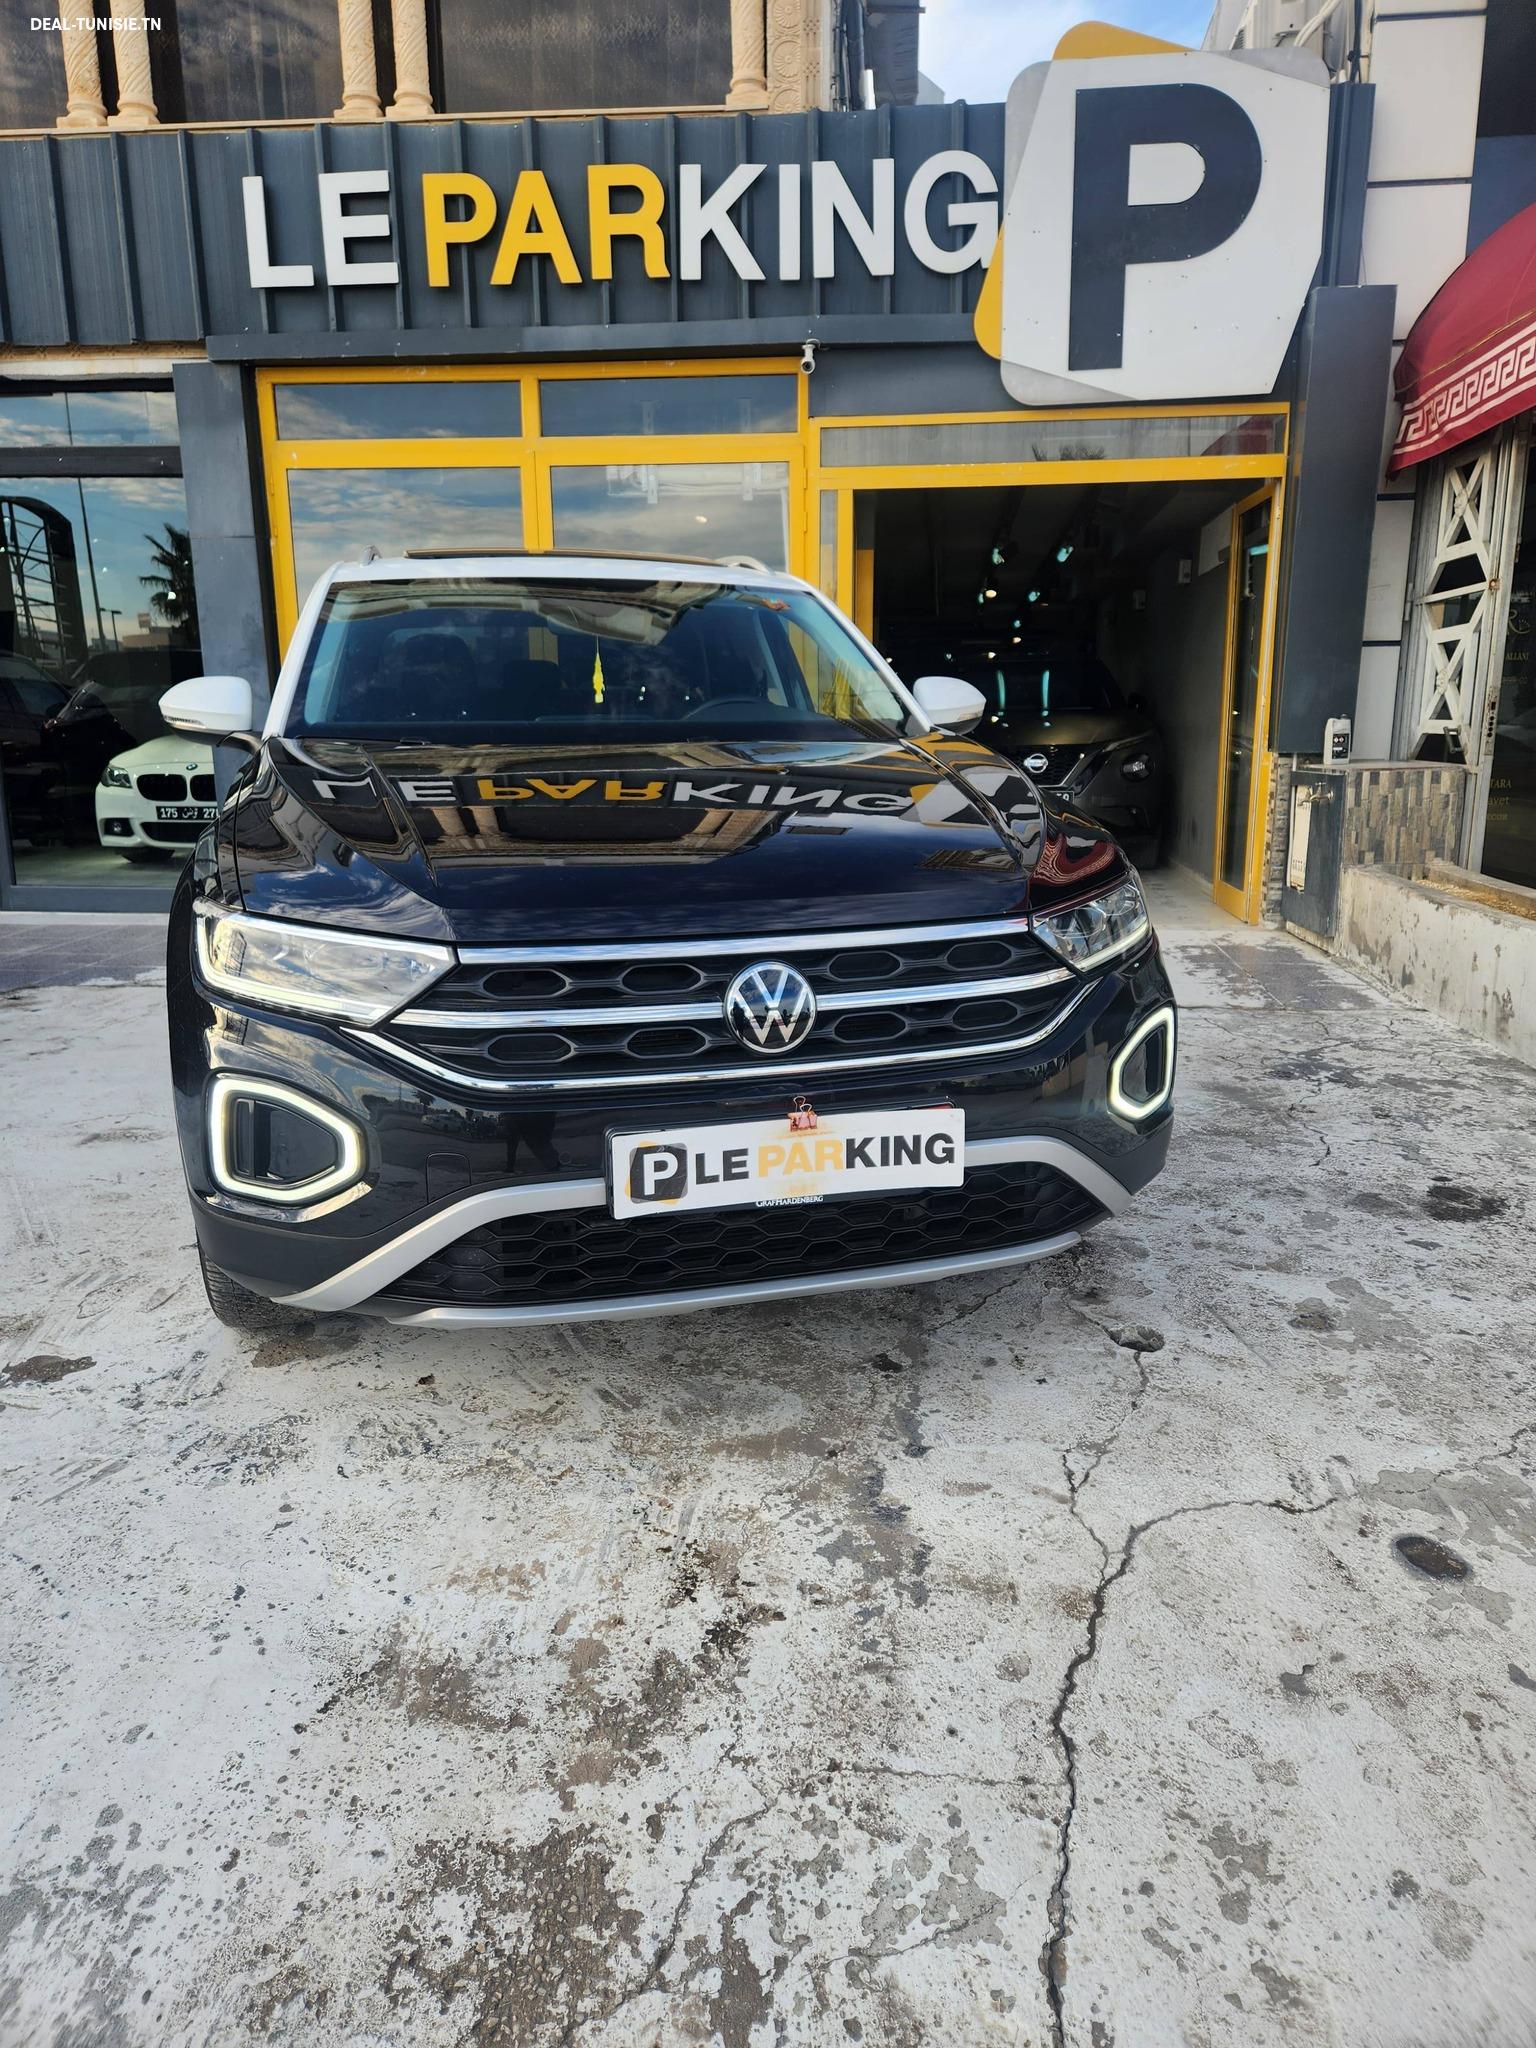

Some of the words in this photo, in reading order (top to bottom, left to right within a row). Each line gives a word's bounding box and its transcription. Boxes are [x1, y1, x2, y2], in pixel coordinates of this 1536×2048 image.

[242, 169, 399, 289] LE
[422, 149, 1000, 288] PARKING
[1068, 83, 1263, 371] P
[160, 807, 178, 818] 175
[694, 1147, 749, 1185] LE
[757, 1132, 956, 1178] PARKING
